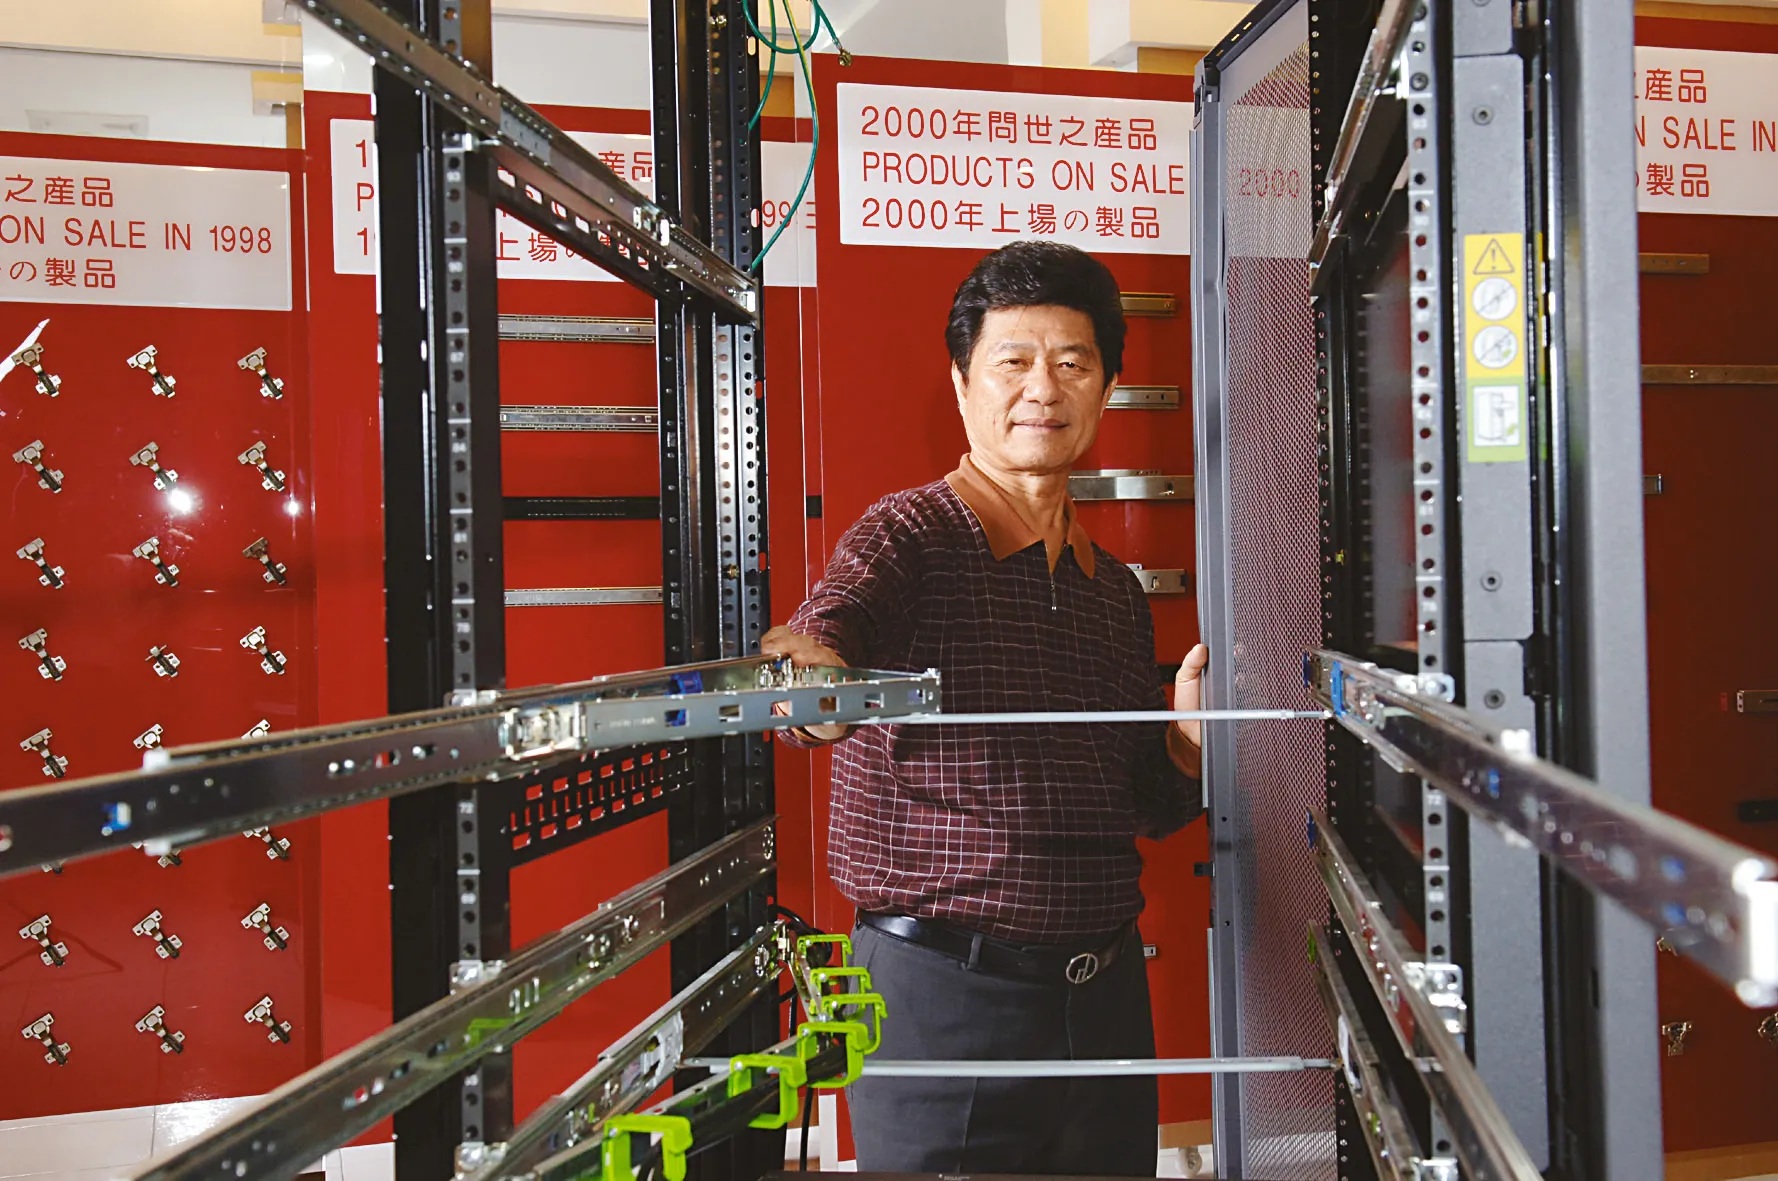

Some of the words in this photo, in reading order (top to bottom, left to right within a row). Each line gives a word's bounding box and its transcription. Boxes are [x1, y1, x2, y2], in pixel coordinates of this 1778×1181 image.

[1634, 68, 1708, 105] 産品
[860, 105, 1157, 152] 2000年問世之産品
[1663, 116, 1737, 151] SALE
[1752, 120, 1777, 153] IN
[5, 174, 114, 208] 之産品
[862, 151, 1035, 190] PRODUCTS
[1051, 159, 1095, 191] ON
[1110, 161, 1185, 196] SALE
[1634, 162, 1710, 198] 製品
[0, 214, 45, 245] ON
[64, 217, 147, 249] SALE
[164, 222, 192, 251] IN
[209, 225, 273, 254] 1998
[861, 197, 1161, 240] 2000年上場の製品
